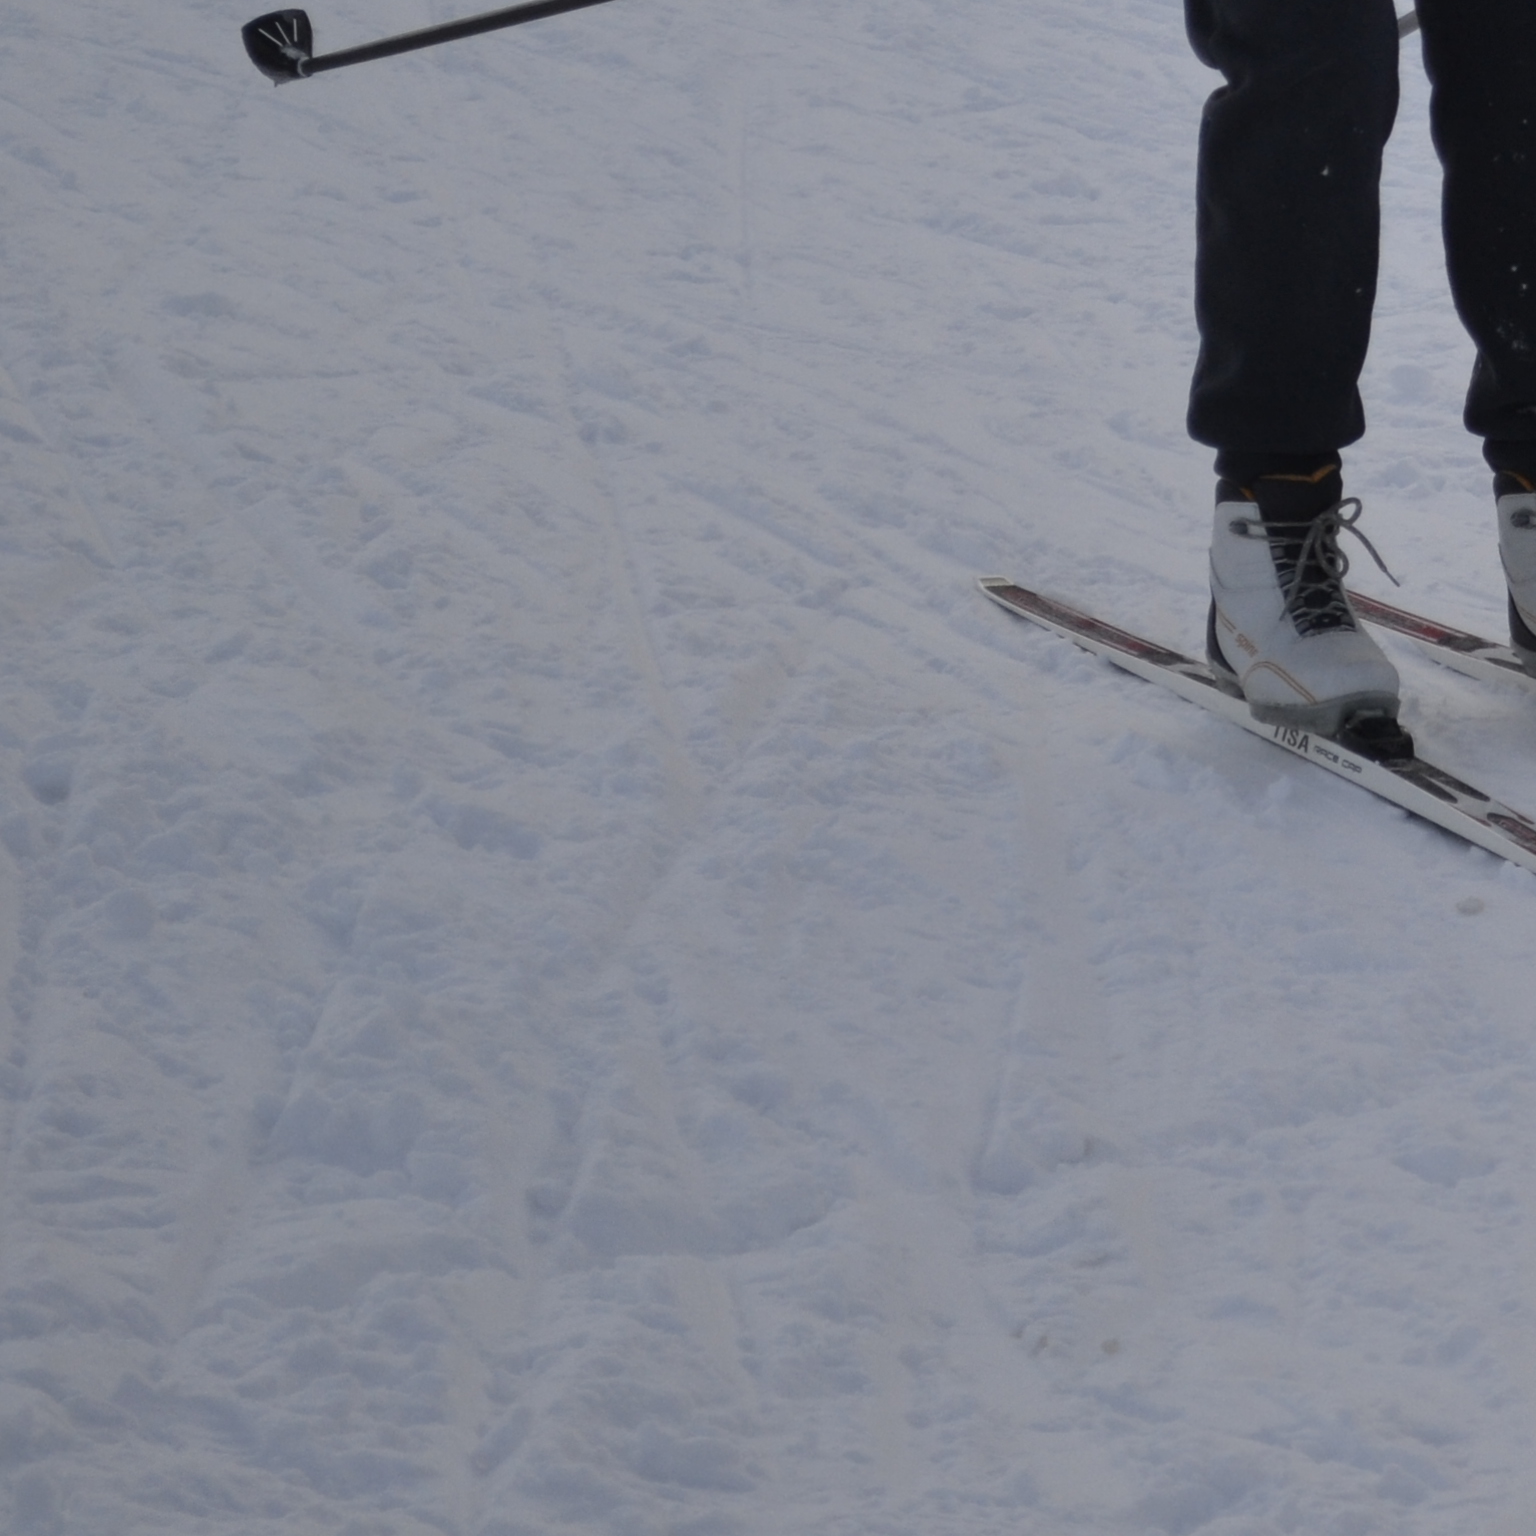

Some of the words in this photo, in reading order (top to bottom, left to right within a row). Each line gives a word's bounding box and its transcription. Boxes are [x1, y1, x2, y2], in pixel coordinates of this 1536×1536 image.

[1273, 725, 1309, 753] TISA
[1314, 745, 1340, 764] RACE
[1341, 759, 1362, 774] CAP
